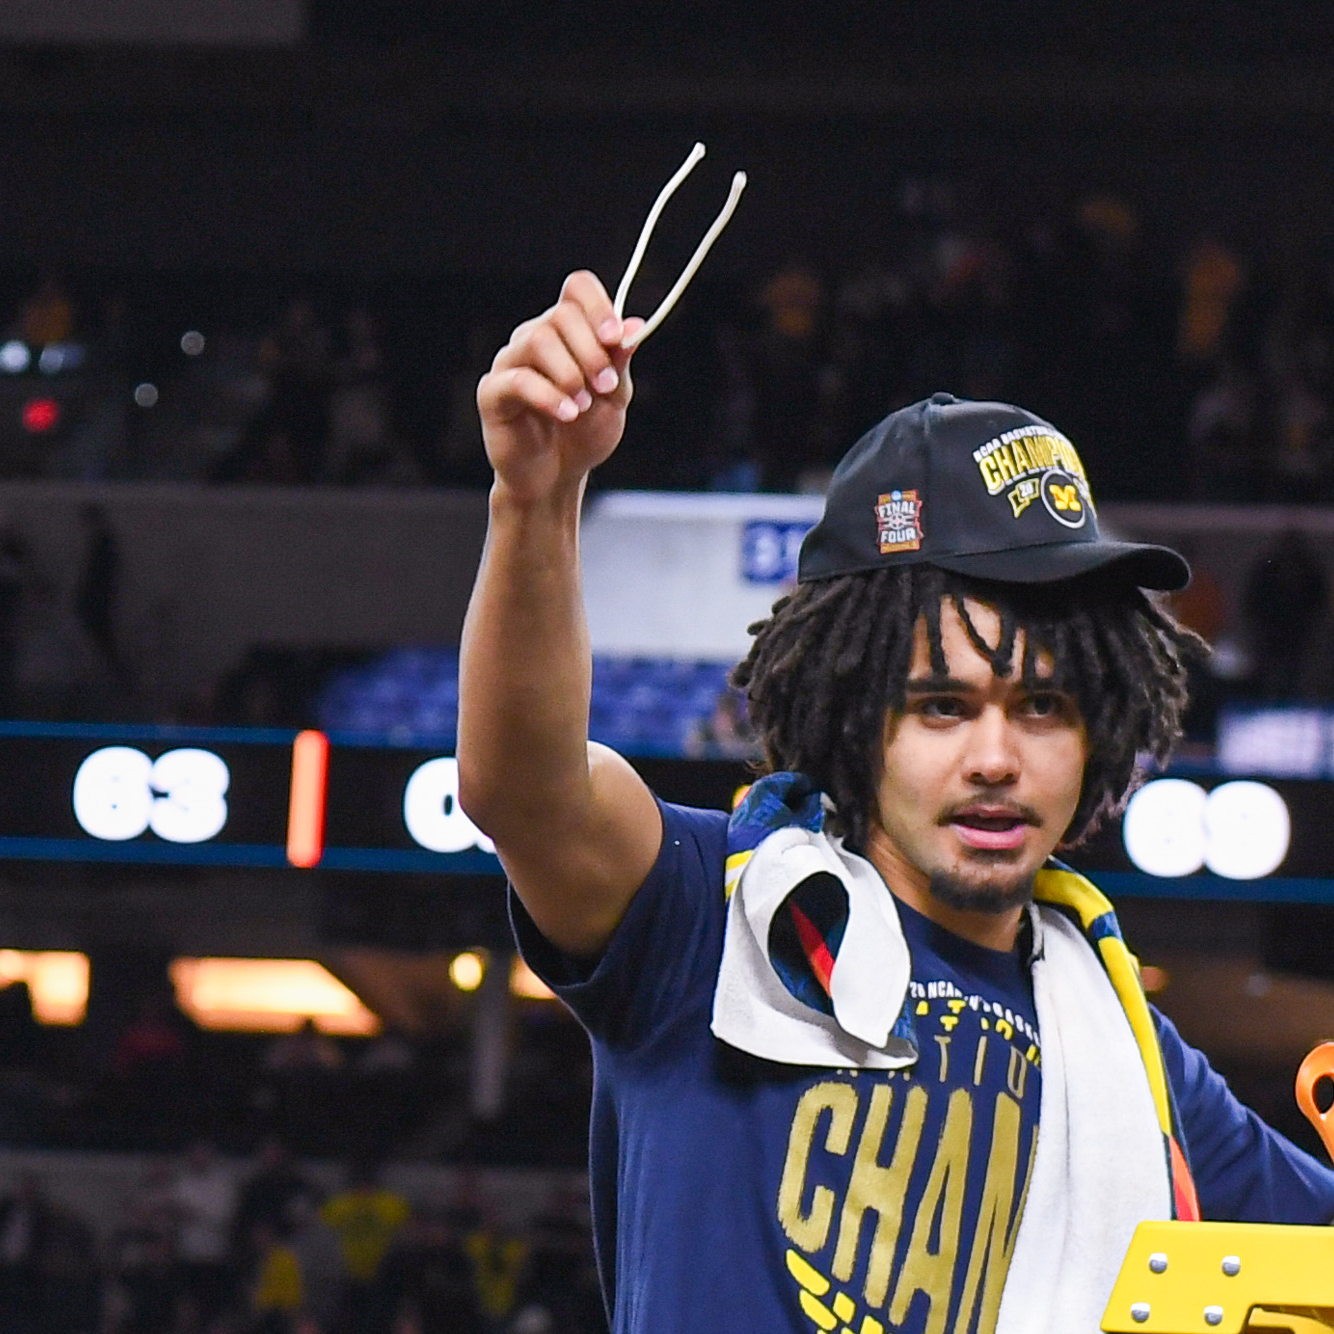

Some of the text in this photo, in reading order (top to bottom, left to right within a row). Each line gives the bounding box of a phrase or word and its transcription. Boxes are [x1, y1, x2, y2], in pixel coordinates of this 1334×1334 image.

[878, 501, 915, 518] FINAL
[880, 527, 916, 543] FOUR
[73, 746, 230, 843] 63
